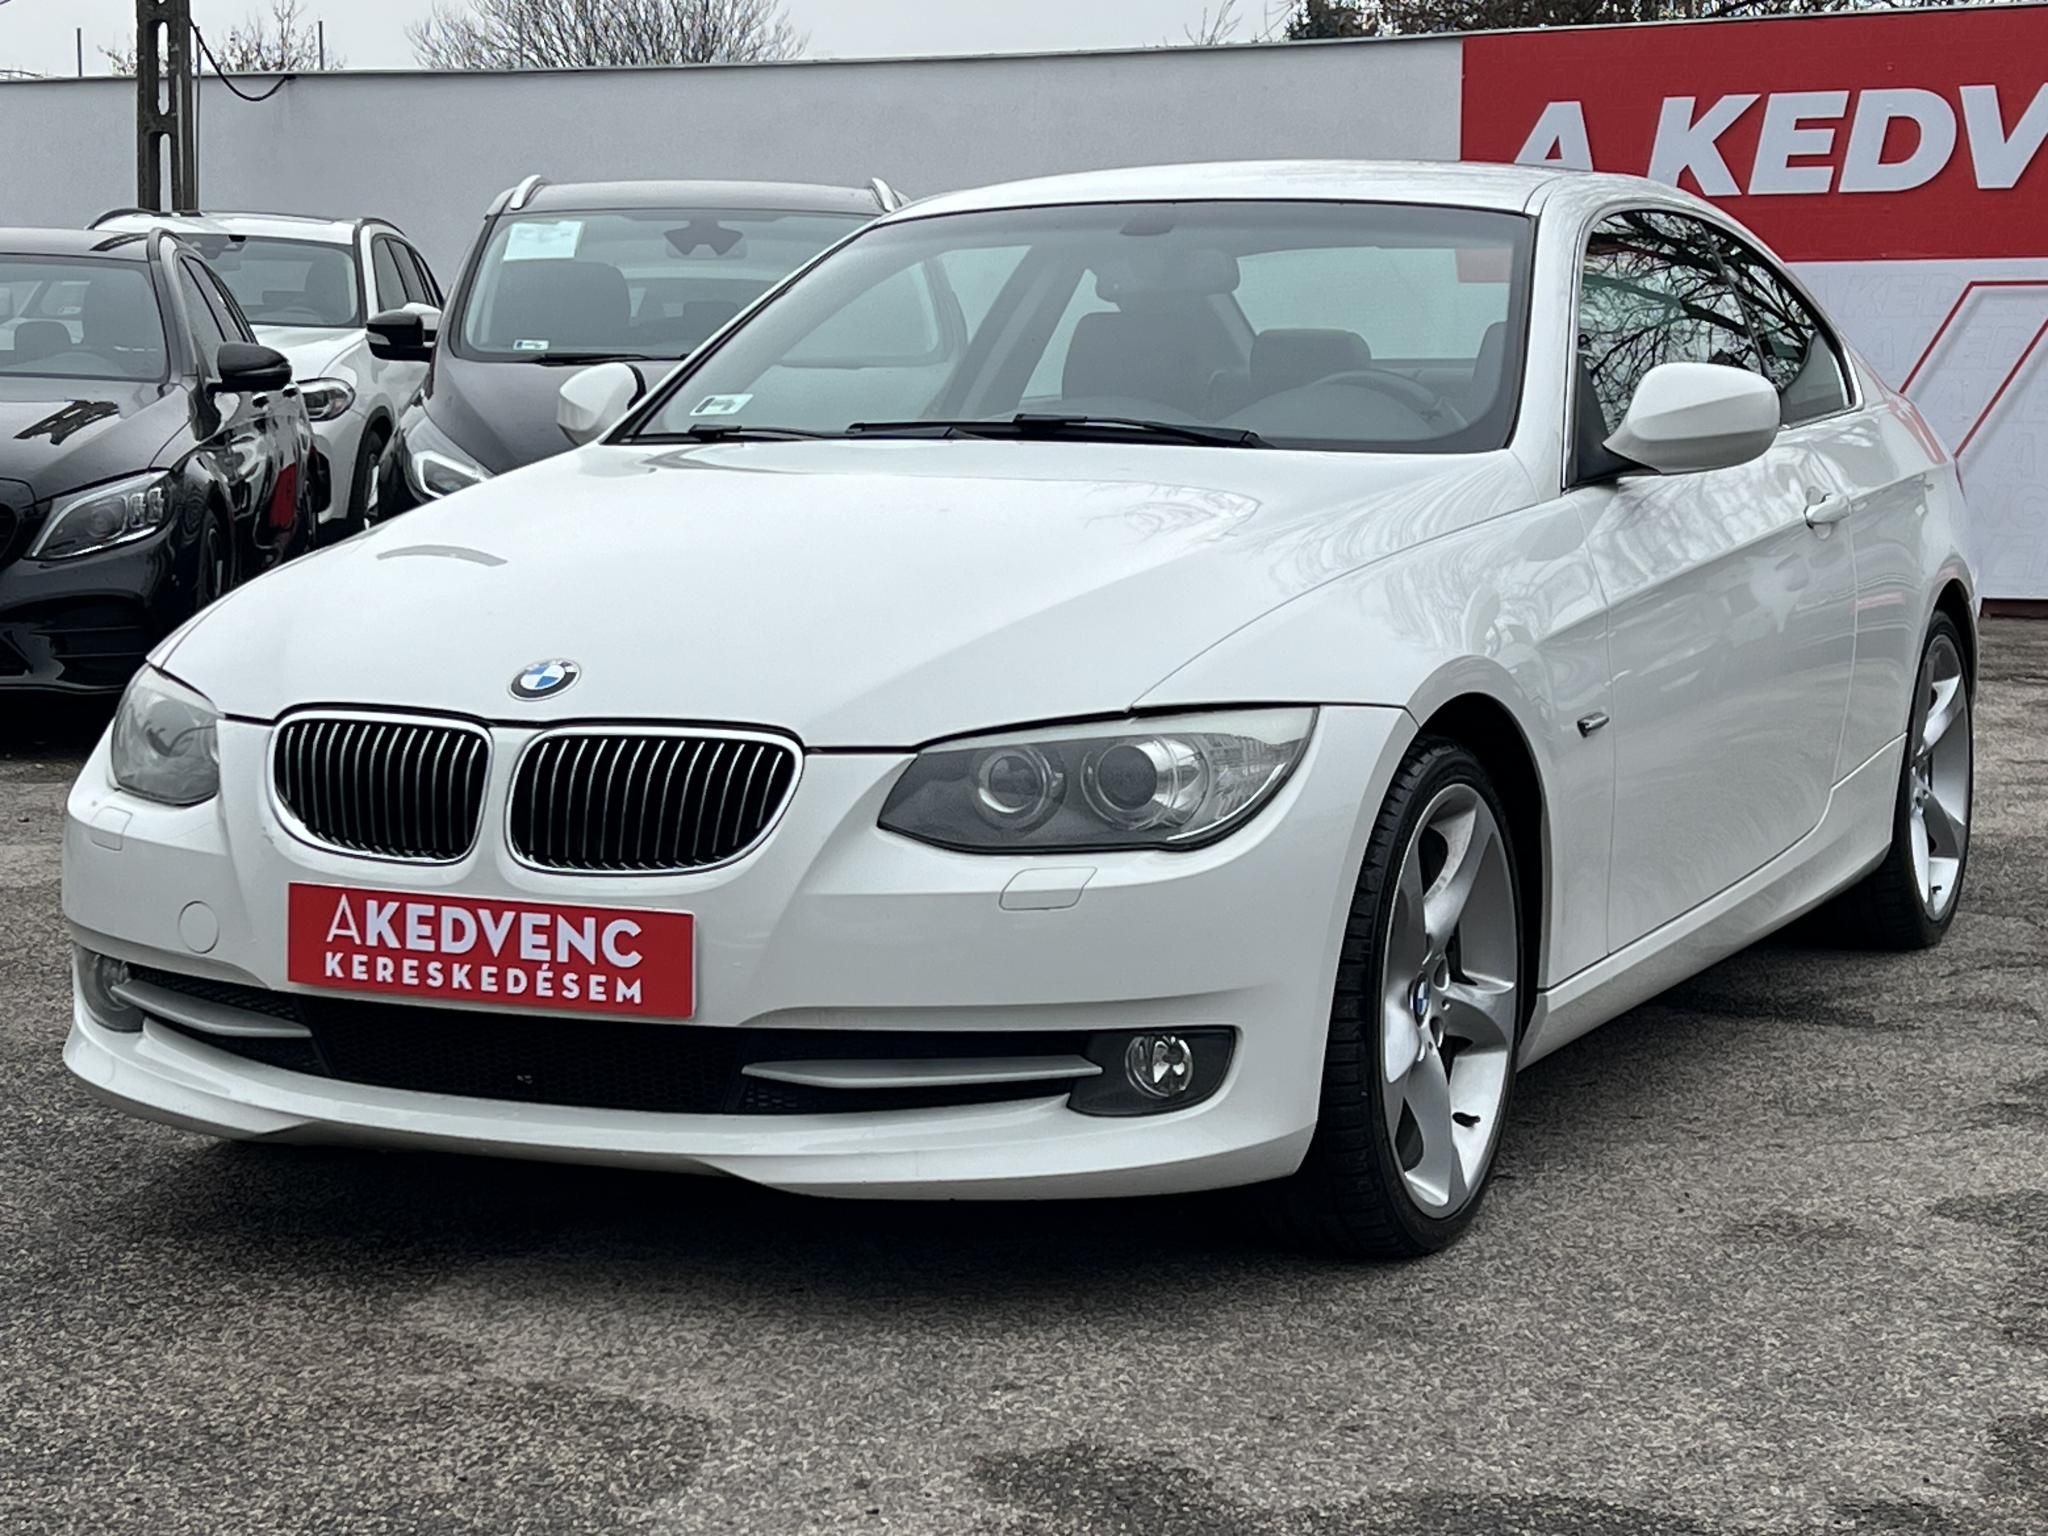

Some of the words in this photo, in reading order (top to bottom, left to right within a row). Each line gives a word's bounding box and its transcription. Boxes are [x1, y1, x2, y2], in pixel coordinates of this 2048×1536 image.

[1515, 100, 1594, 171] A
[1648, 83, 2048, 195] KEDV
[326, 893, 643, 968] AKEDVENC
[325, 951, 642, 1004] KERESKEDÉSEM
